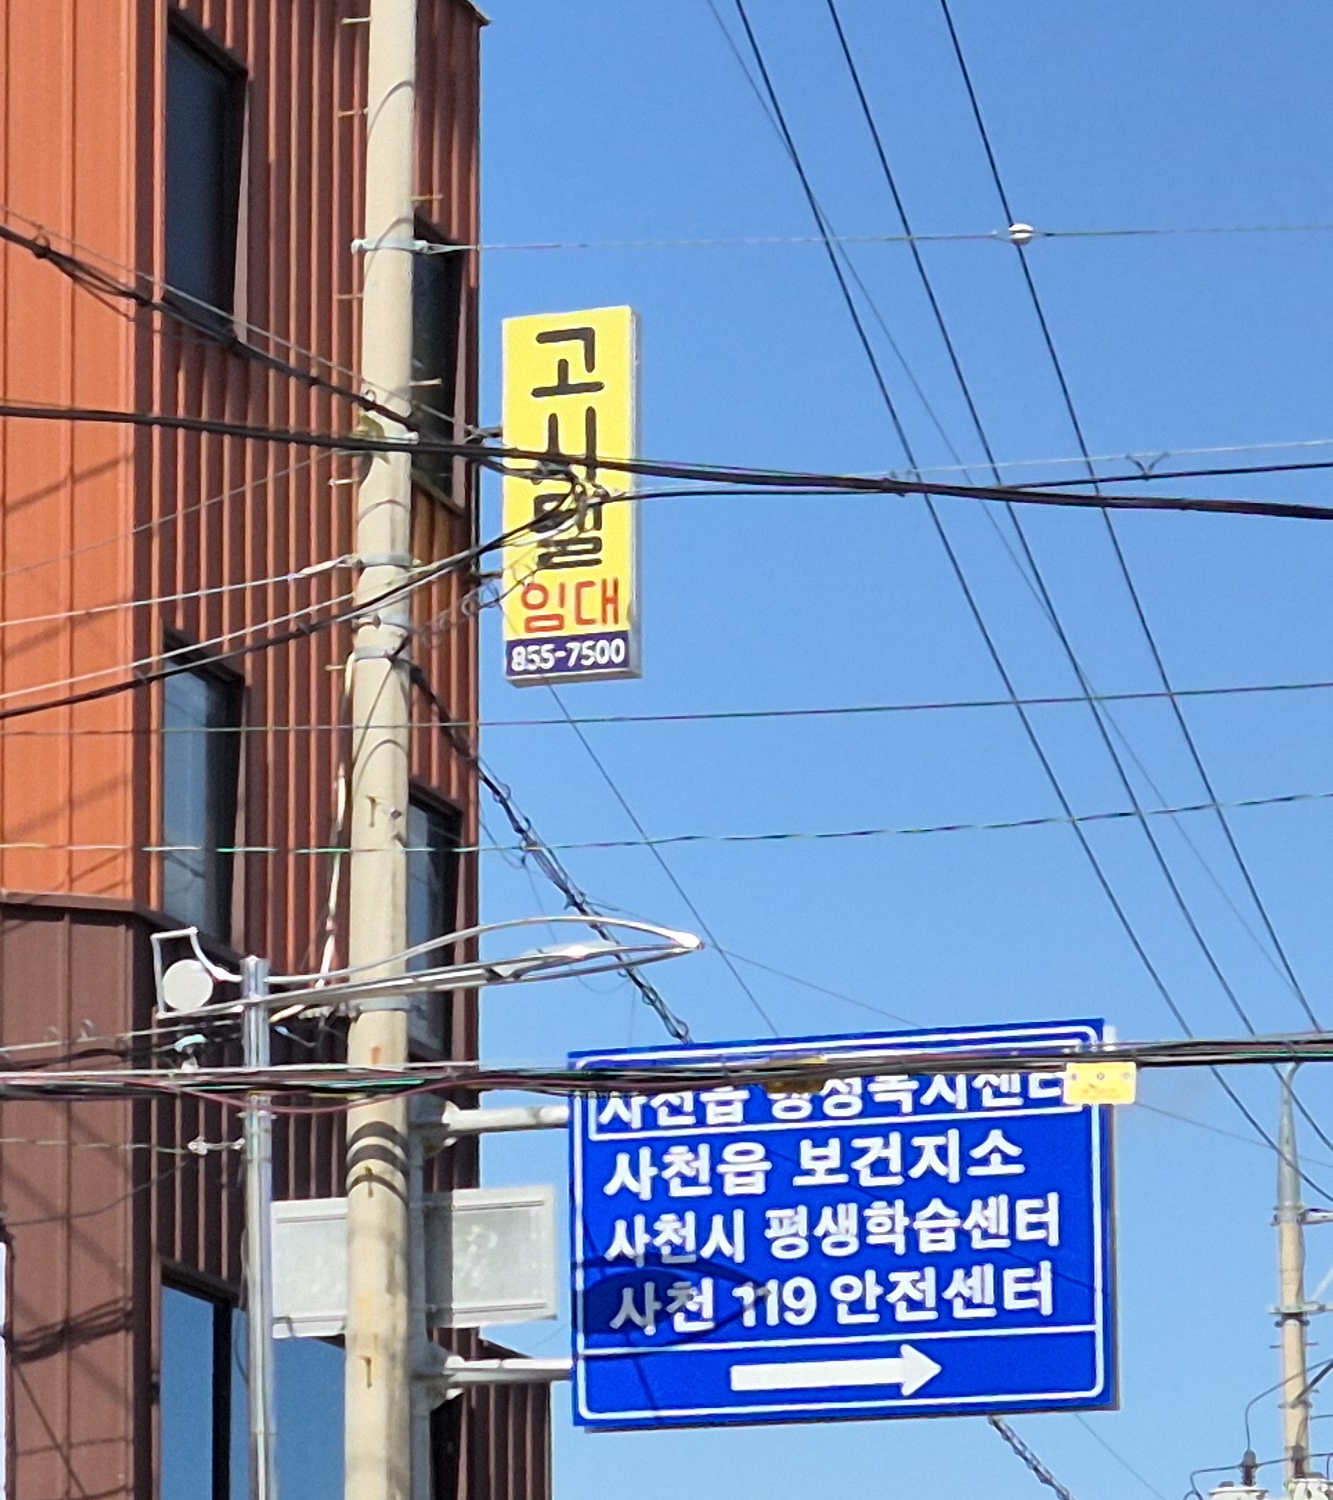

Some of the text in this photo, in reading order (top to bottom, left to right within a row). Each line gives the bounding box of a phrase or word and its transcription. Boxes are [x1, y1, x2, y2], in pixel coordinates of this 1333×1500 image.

[521, 577, 619, 633] 임대
[511, 638, 626, 672] 855-7500
[603, 1128, 1026, 1200] 사천읍 보건지소
[604, 1191, 1061, 1267] 사천시 평생학습센터
[609, 1261, 1054, 1335] 사천 119 안전센터
